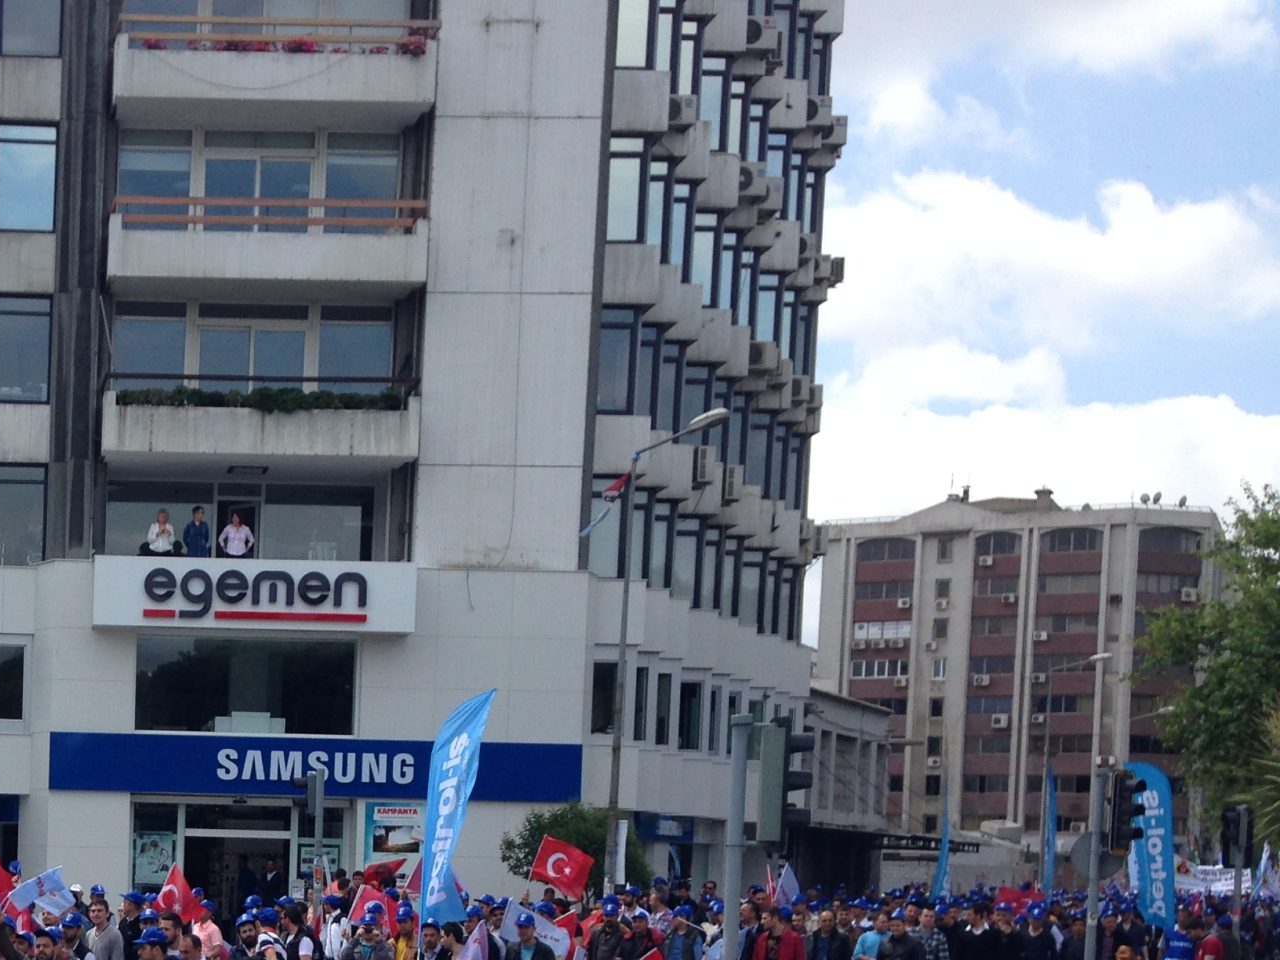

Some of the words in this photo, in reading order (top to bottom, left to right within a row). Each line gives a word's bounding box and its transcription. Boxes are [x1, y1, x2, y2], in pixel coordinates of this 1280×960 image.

[144, 567, 368, 618] egemen
[216, 748, 415, 785] SAMSUNG
[377, 807, 418, 816] KAMPANYA
